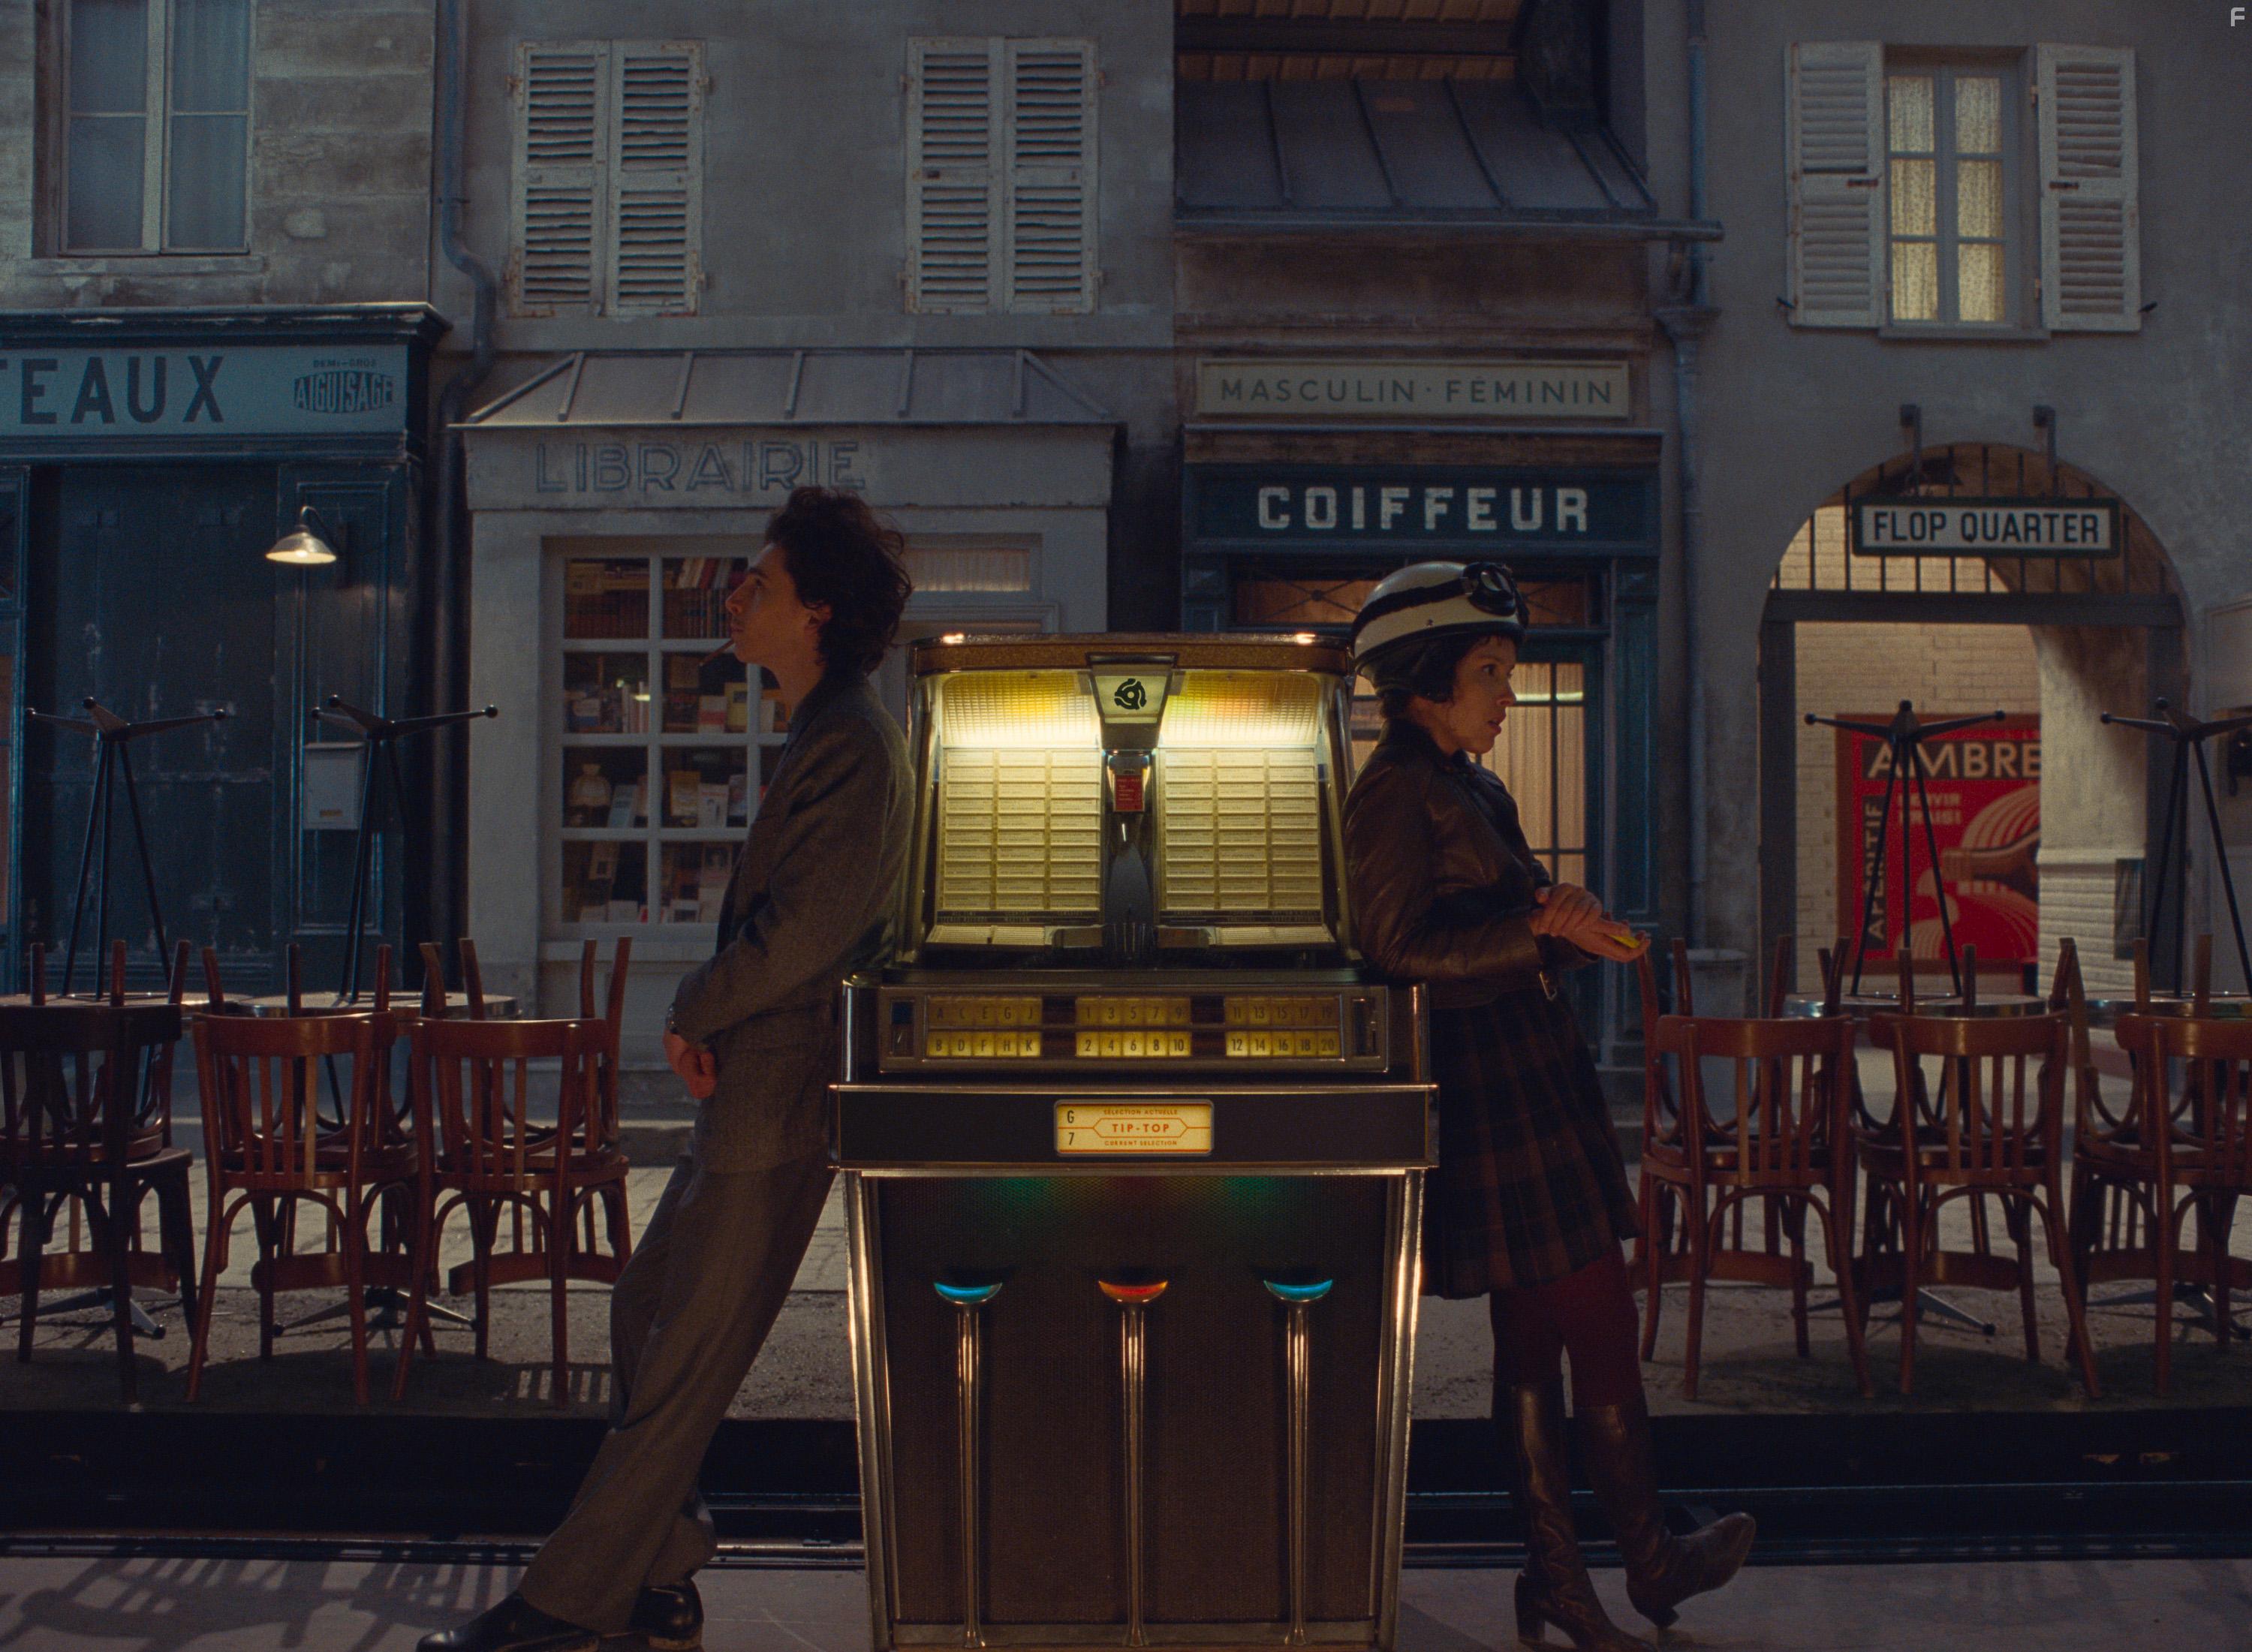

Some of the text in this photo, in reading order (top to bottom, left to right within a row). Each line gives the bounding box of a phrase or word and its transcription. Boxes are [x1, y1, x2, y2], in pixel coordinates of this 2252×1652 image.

[0, 357, 224, 425] EAUX
[294, 371, 393, 413] AIGUISAGE
[1221, 379, 1415, 403] MASCULIN
[535, 441, 866, 493] LIBRAIRIE
[1258, 486, 1588, 532] COIFFEUR
[1874, 511, 2100, 543] FLOP QUARTER
[1085, 1007, 1182, 1019] 1 3 5 7 9
[1233, 1007, 1332, 1019] 11 13 15 17 19
[935, 1040, 1033, 1052] B D F H K
[1085, 1039, 1185, 1052] 2 4 6 8 10
[1232, 1039, 1335, 1052] 12 14 16 18 20
[1067, 1109, 1075, 1124] G
[1112, 1124, 1170, 1133] TIP-TOP
[1068, 1132, 1075, 1146] 7
